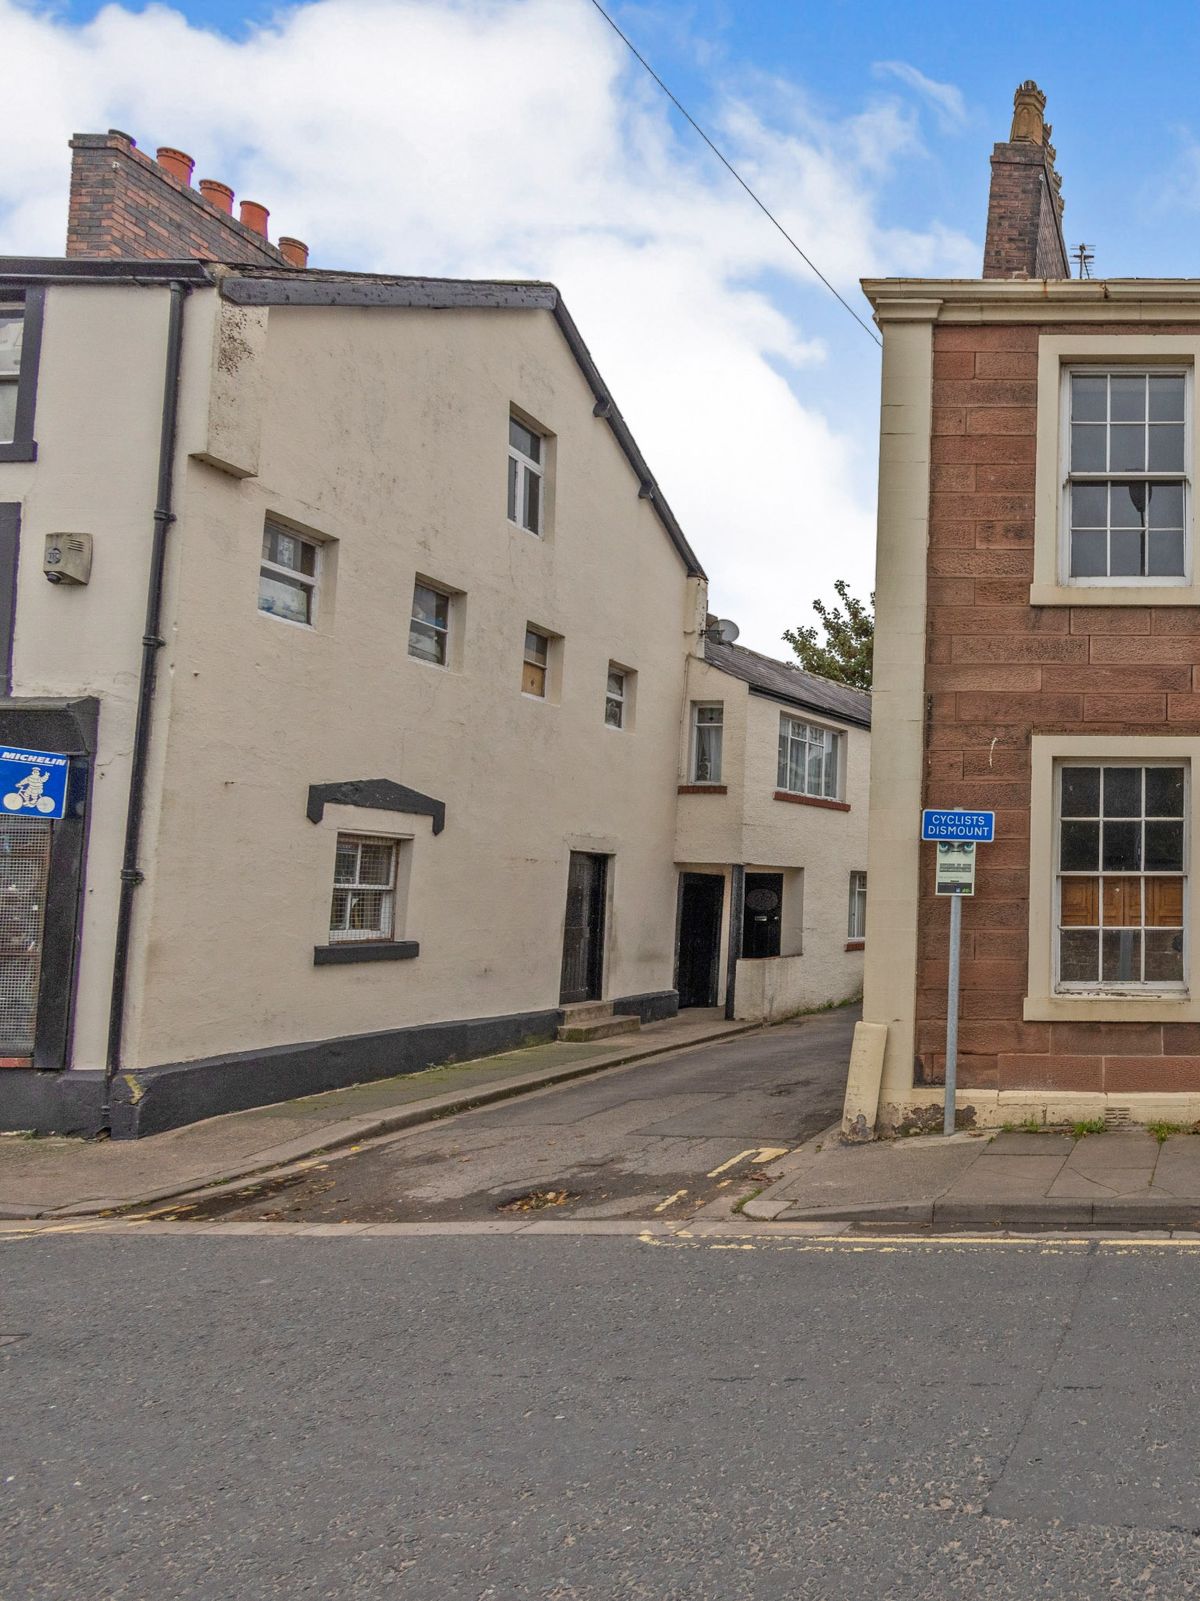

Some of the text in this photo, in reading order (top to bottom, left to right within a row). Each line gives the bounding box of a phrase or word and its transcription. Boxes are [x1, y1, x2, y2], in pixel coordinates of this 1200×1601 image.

[2, 752, 67, 766] MICHELIN
[932, 814, 985, 825] CYCLISTS
[928, 826, 989, 837] DISMOUNT
